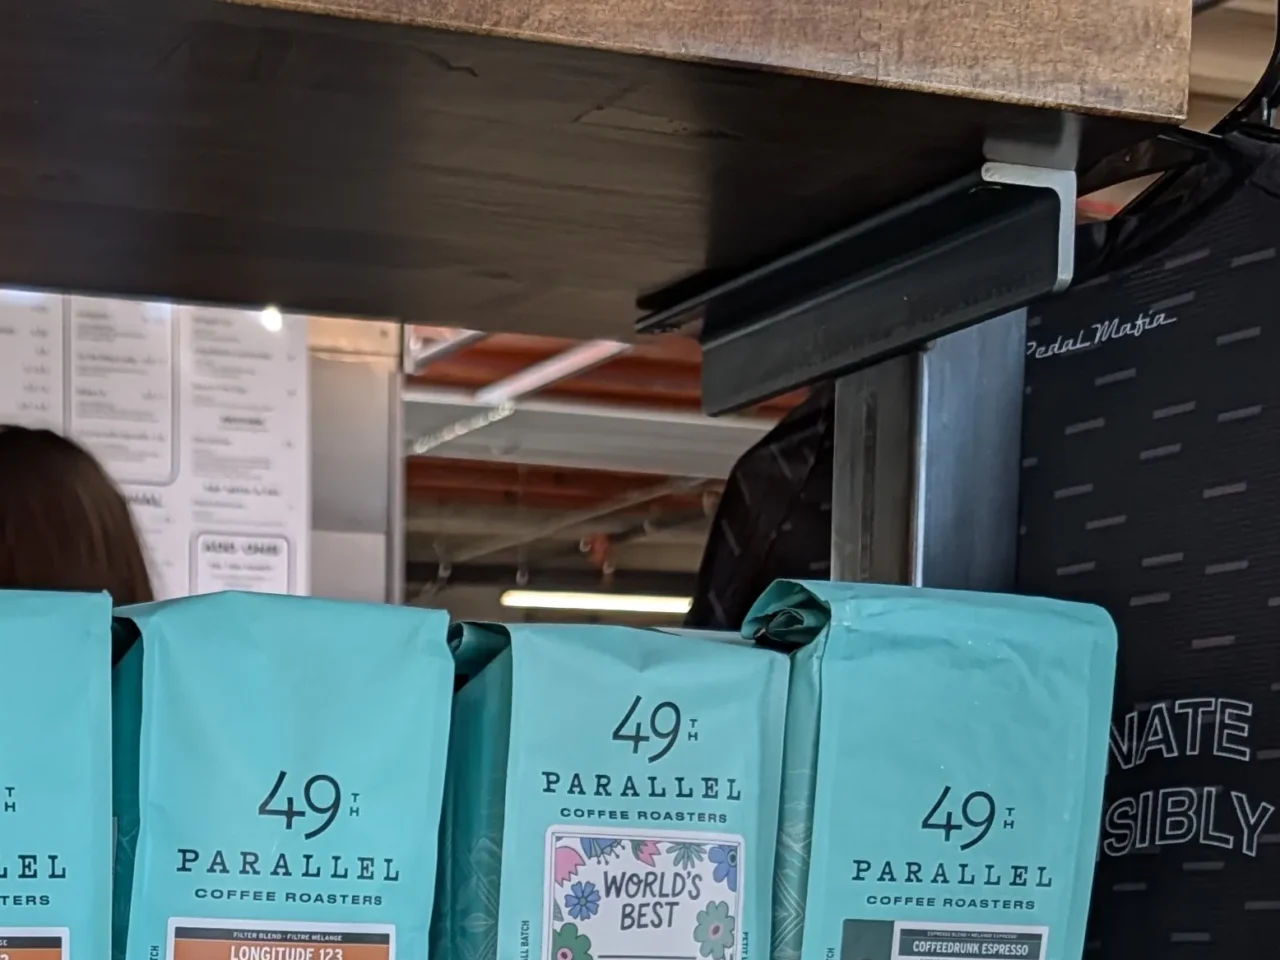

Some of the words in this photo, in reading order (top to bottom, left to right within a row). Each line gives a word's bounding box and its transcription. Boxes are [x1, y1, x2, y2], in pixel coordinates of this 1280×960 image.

[1092, 310, 1178, 344] Mafia
[612, 695, 681, 764] 49
[542, 771, 741, 801] PARALLEL
[258, 770, 342, 840] 49
[560, 808, 630, 820] COFFEE
[637, 811, 728, 824] ROASTERS
[921, 785, 996, 852] 49
[1104, 786, 1275, 857] SIBLY
[176, 848, 400, 882] PARALLEL
[852, 859, 1053, 888] PARALLEL
[194, 888, 276, 902] COFFEE
[285, 892, 383, 906] ROASTERS
[603, 871, 703, 900] WORLD'S
[620, 901, 679, 931] BEST
[866, 895, 936, 908] COFFEE
[943, 898, 1036, 910] ROASTERS
[521, 920, 530, 947] BATCH
[913, 941, 980, 954] COFFEEDRUNK
[981, 944, 1029, 956] ESPRESSO
